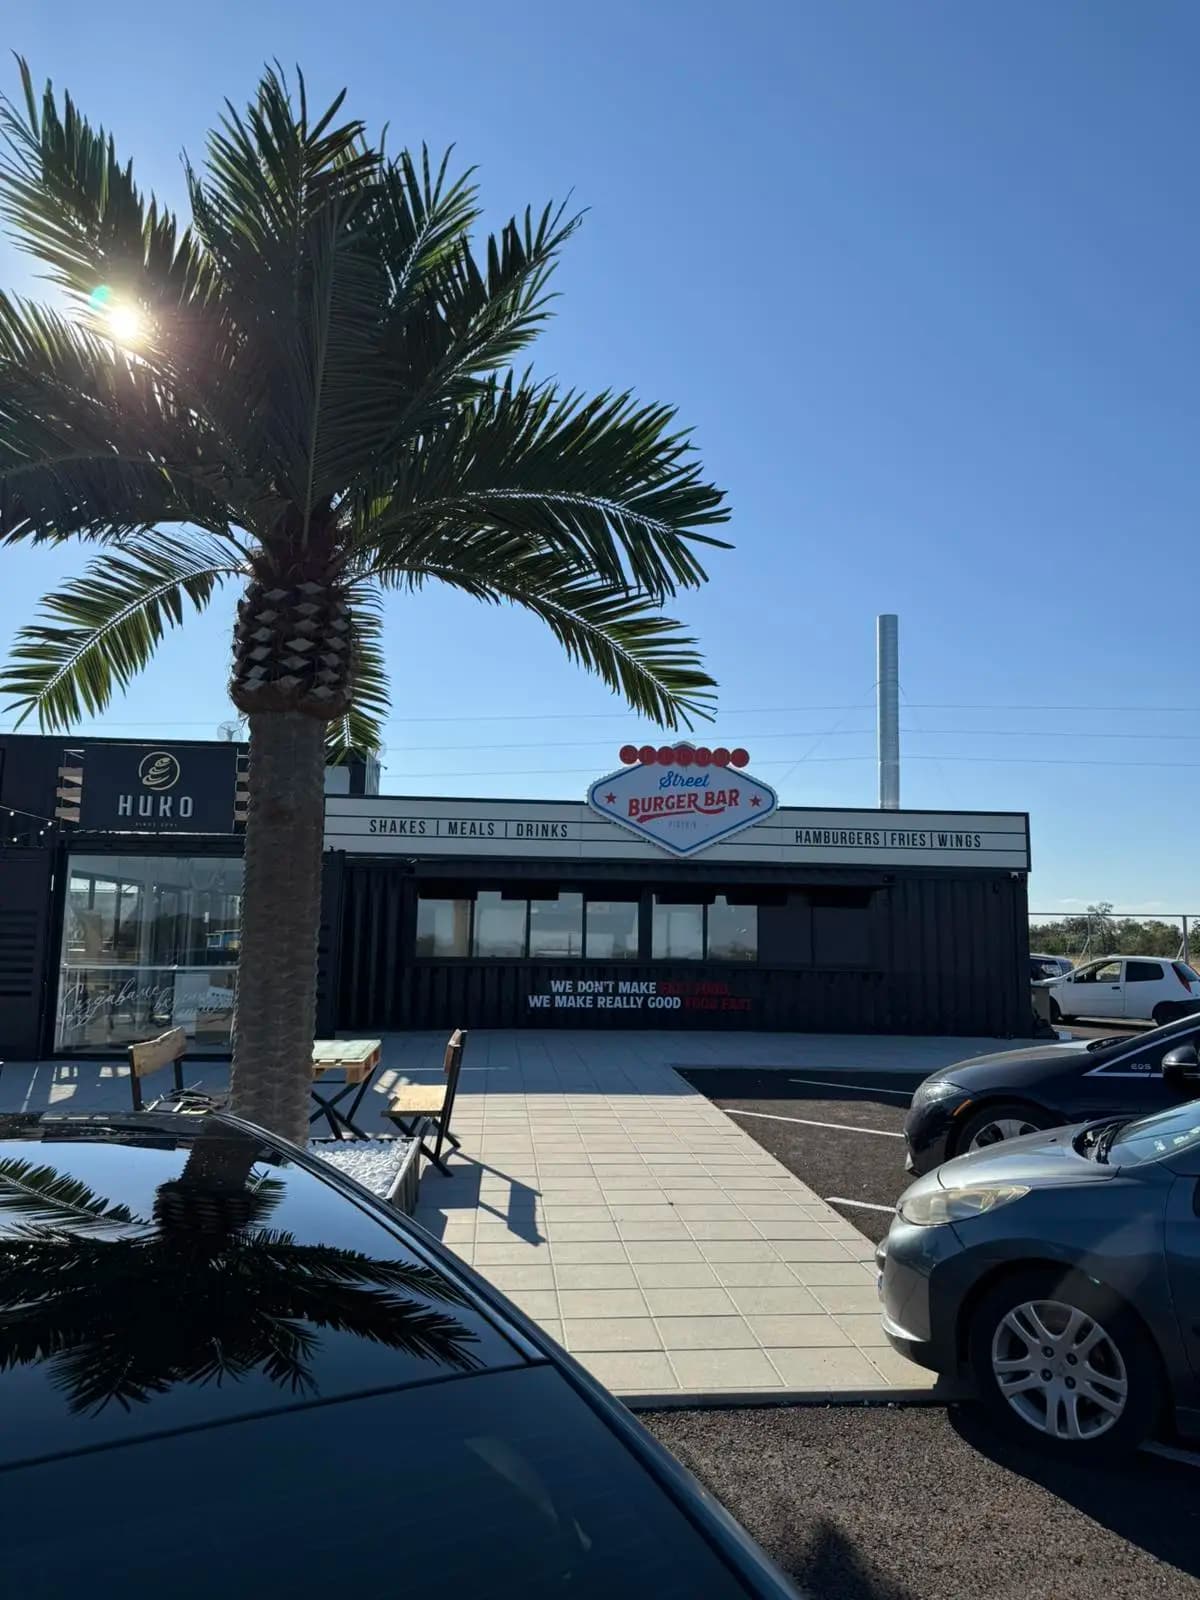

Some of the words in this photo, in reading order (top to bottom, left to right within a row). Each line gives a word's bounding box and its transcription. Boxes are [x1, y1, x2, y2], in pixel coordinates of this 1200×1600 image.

[659, 770, 711, 790] Street
[118, 794, 193, 818] HUKO
[628, 792, 699, 818] BURGER
[704, 788, 740, 808] BAR
[369, 818, 426, 835] SHAKES
[448, 820, 495, 837] MEALS
[516, 822, 569, 838] DRINKS
[795, 829, 880, 846] HAMBURGERS
[890, 832, 926, 847] FRIES
[937, 833, 982, 848] WINGS
[550, 979, 573, 993] WE
[577, 980, 615, 993] DON'T
[618, 981, 657, 994] MAKE
[528, 994, 551, 1008] WE
[554, 995, 593, 1009] MAKE
[597, 996, 644, 1009] REALLY
[647, 996, 681, 1009] GOOD
